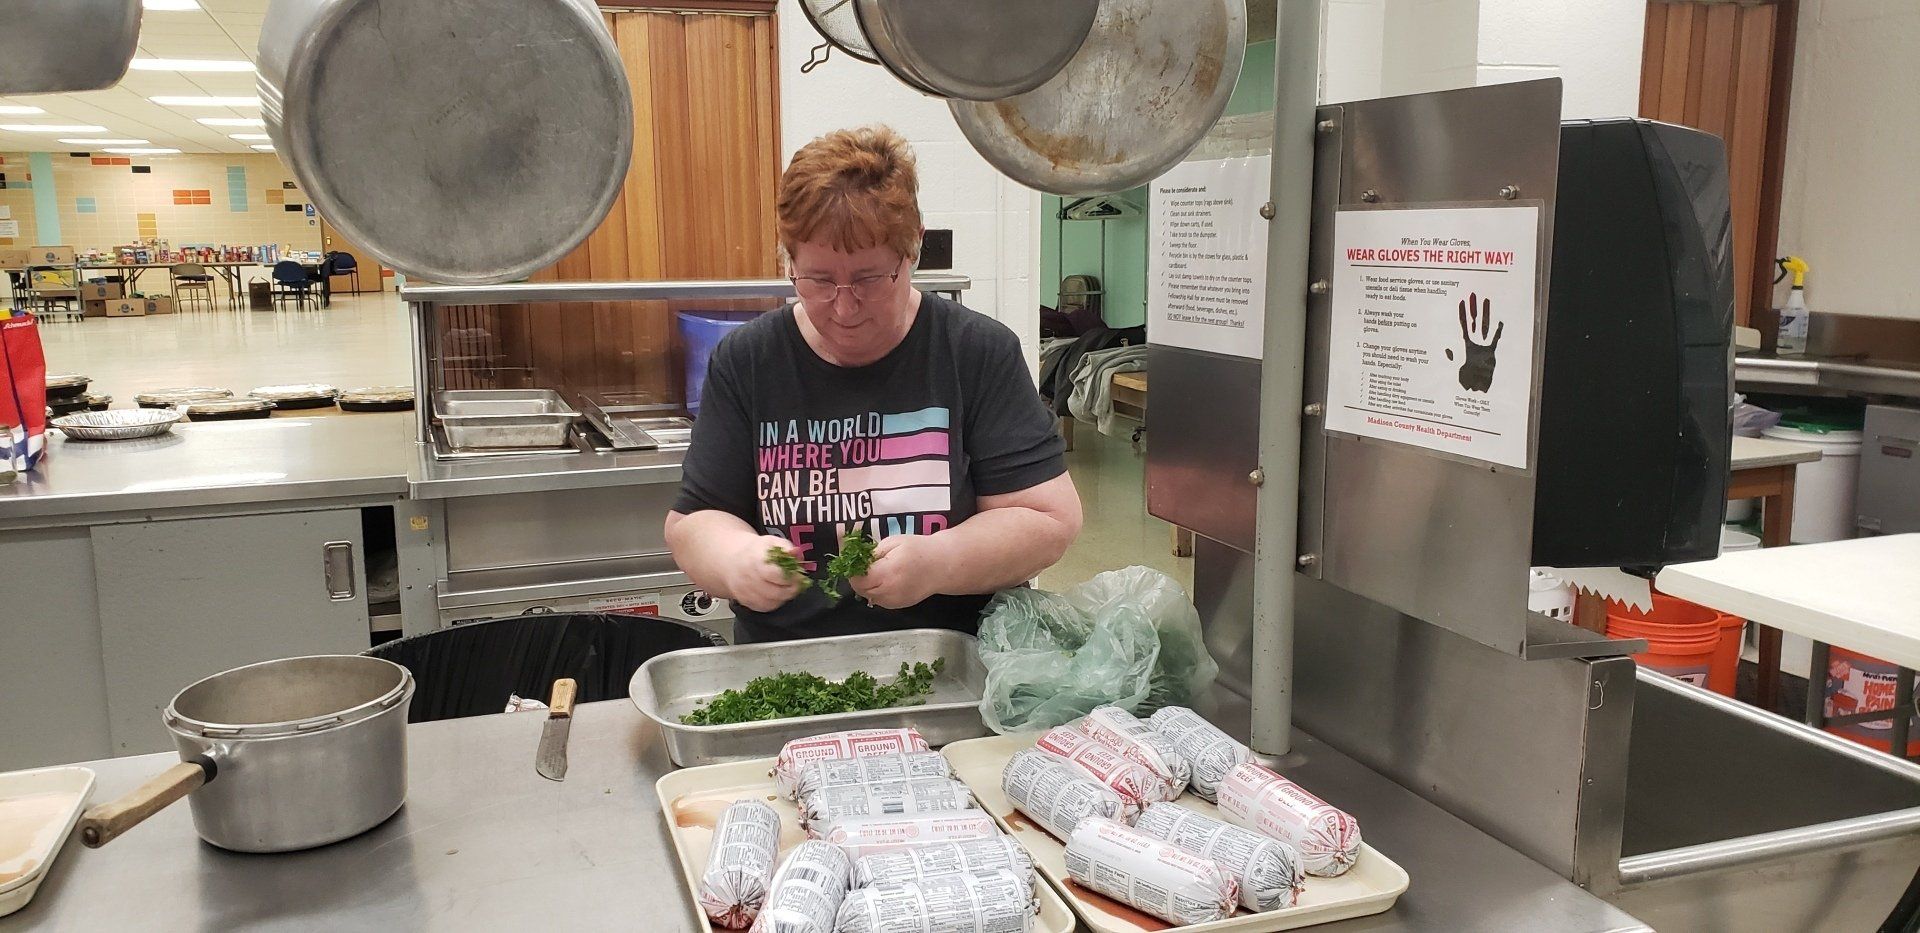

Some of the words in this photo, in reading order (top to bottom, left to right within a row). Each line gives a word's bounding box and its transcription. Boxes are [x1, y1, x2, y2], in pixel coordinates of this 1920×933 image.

[1450, 238, 1471, 247] Gloves,
[1347, 249, 1374, 260] WEAR
[1378, 250, 1419, 262] GLOVES
[1423, 250, 1443, 262] THE
[1447, 251, 1481, 264] RIGHT
[1485, 252, 1513, 265] WAY!
[1364, 309, 1380, 318] Always
[759, 421, 778, 446] IN
[786, 420, 799, 443] A
[808, 412, 880, 443] WORLD
[1368, 417, 1392, 426] Madison
[1394, 421, 1415, 431] County
[1417, 425, 1435, 434] Health
[1437, 429, 1471, 441] Department
[758, 444, 832, 472] WHERE
[840, 438, 881, 464] YOU
[757, 470, 799, 499] CAN
[809, 468, 837, 495] BE
[761, 491, 871, 525] ANYTHING
[858, 742, 896, 752] GROUND
[1048, 732, 1074, 748] GROUND
[796, 748, 834, 759] GROUND
[1084, 752, 1112, 770] GROUND
[1236, 772, 1254, 783] BEEF
[1241, 763, 1269, 780] GROUND
[1281, 788, 1314, 806] GROUND
